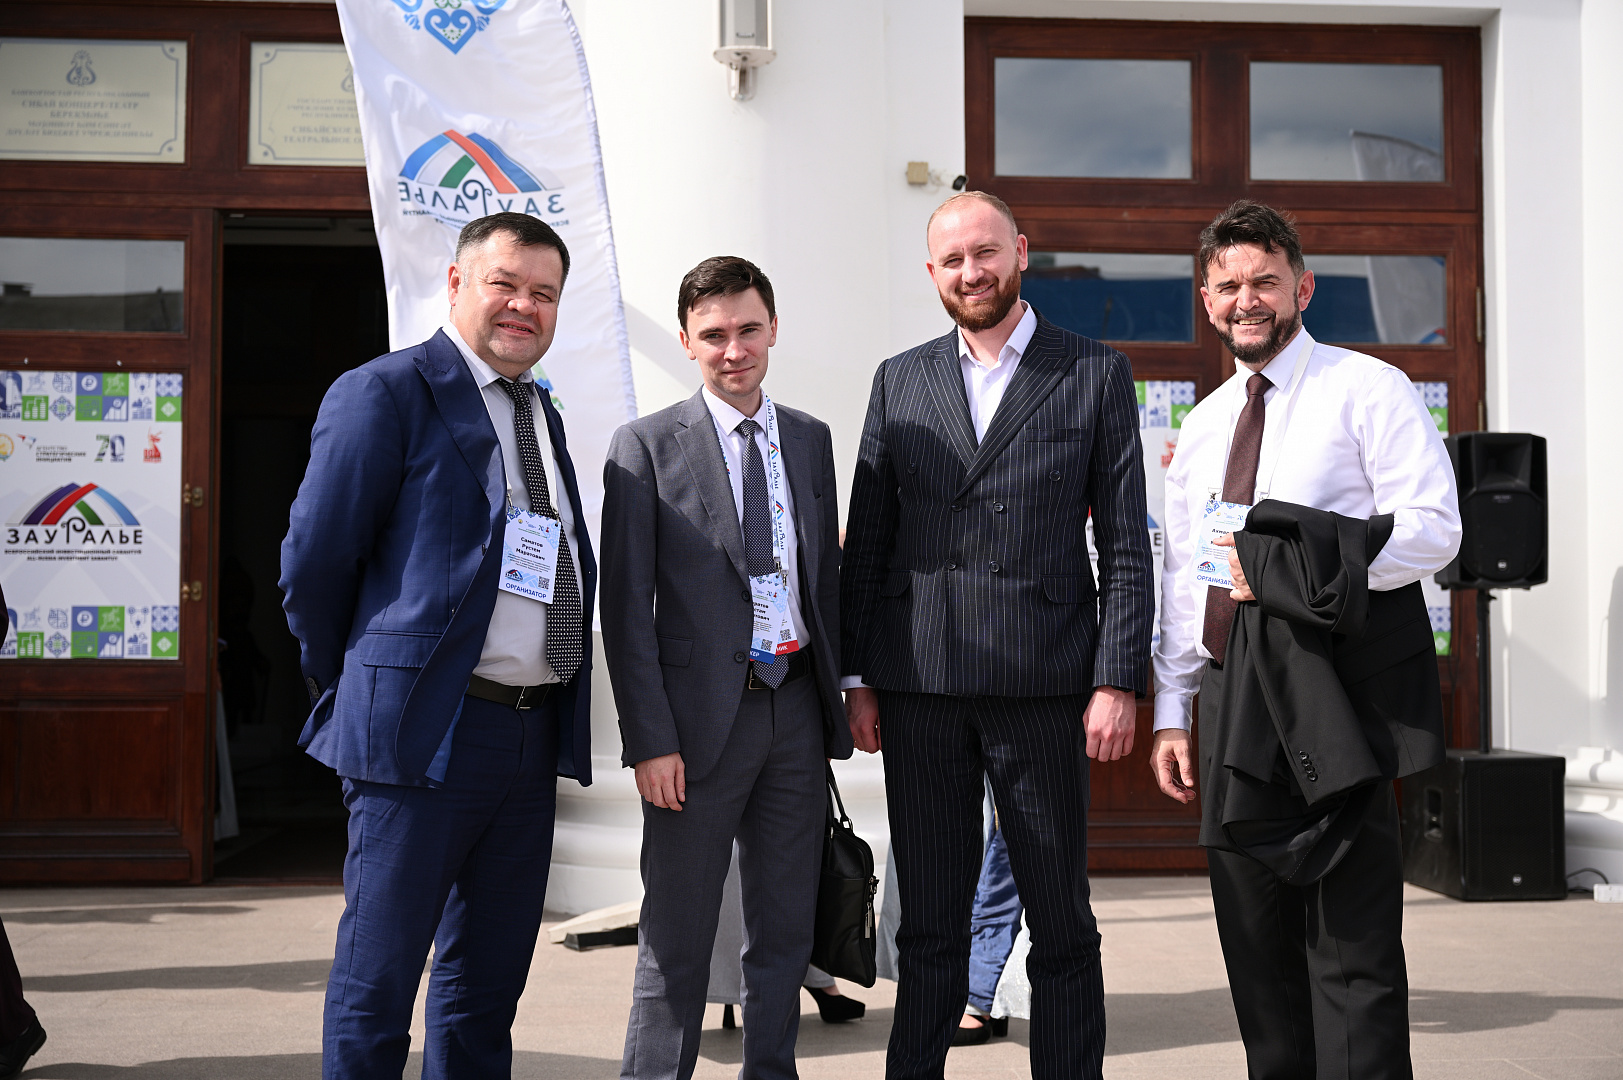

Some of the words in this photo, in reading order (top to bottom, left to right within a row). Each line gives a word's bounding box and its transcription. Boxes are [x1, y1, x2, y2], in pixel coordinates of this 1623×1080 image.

[6, 516, 143, 545] ЗАУРАЛЬЕ
[520, 536, 544, 548] Саматов
[521, 543, 541, 553] Рустем
[516, 548, 545, 560] Маратович
[505, 583, 547, 598] ОРГАНИЗАТОР
